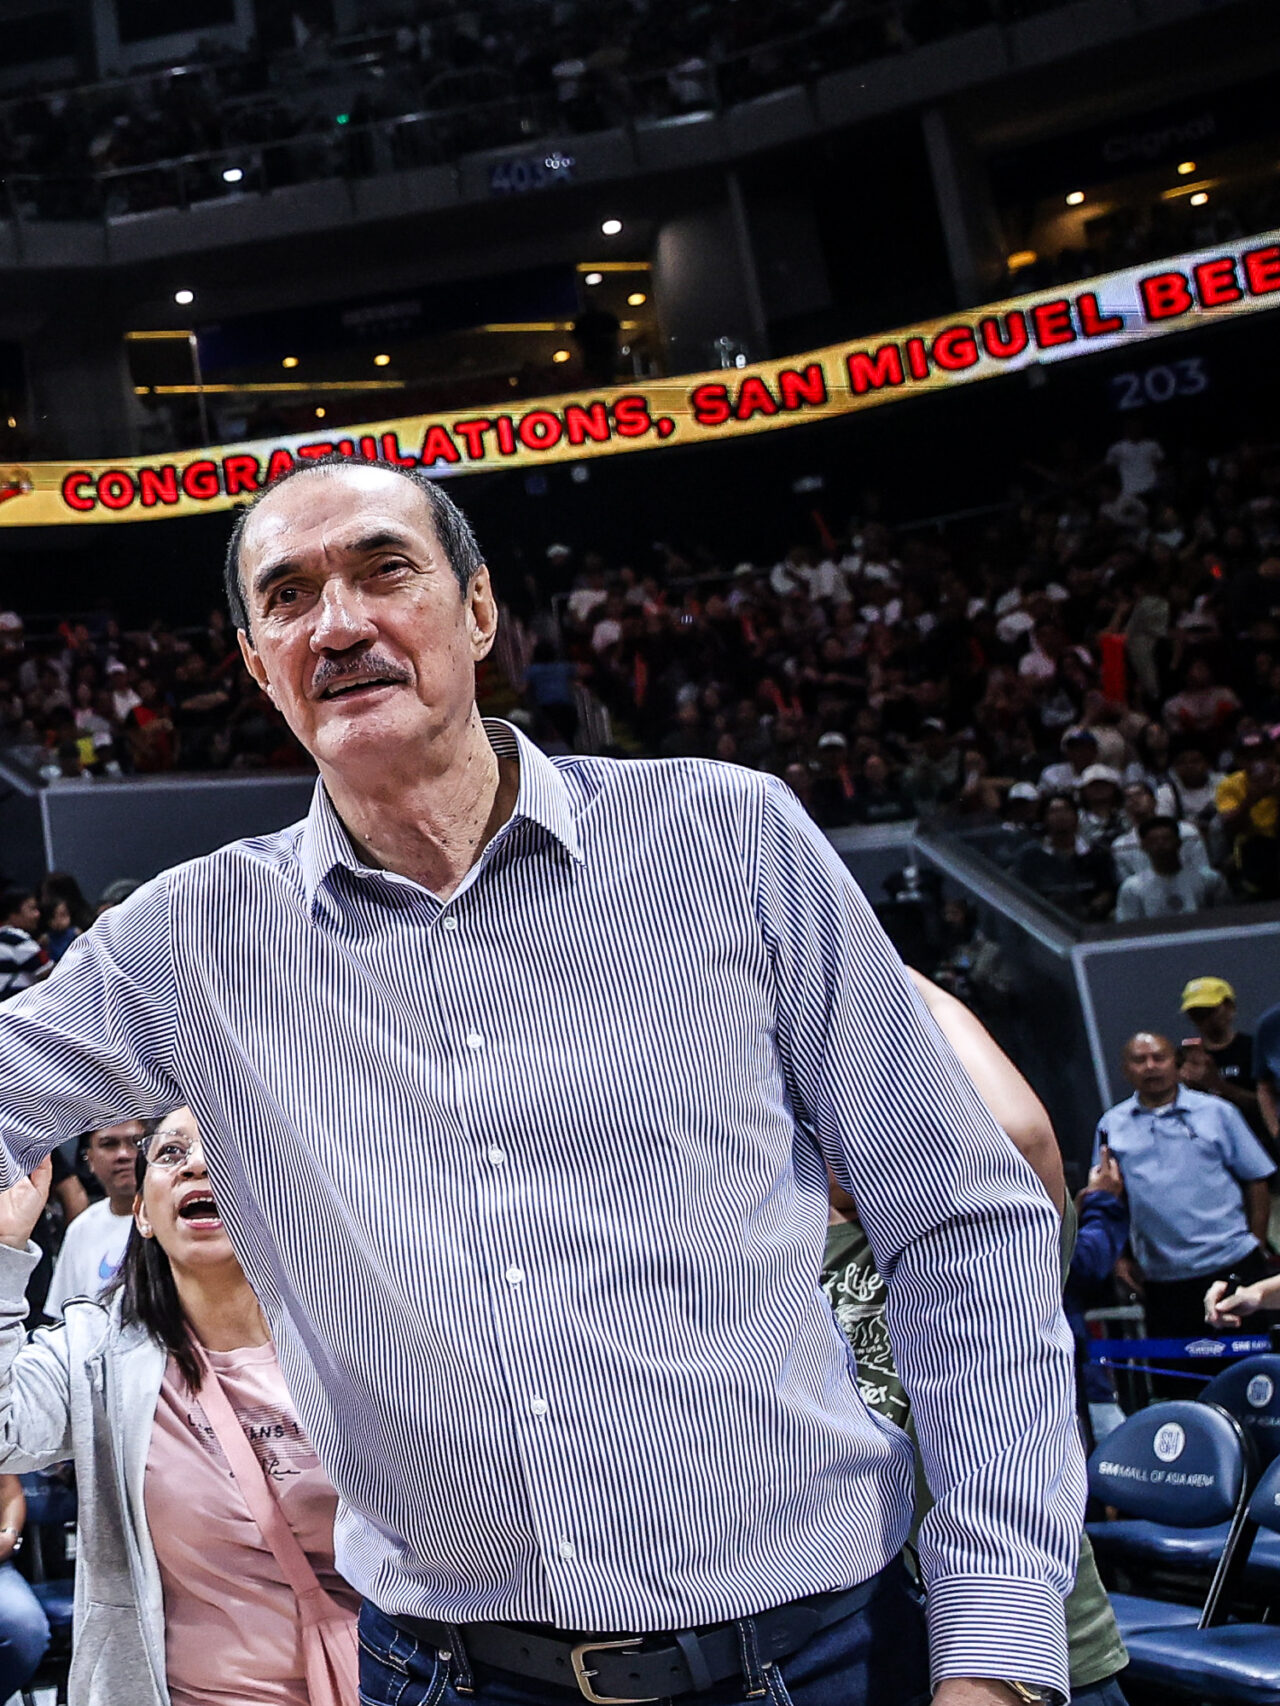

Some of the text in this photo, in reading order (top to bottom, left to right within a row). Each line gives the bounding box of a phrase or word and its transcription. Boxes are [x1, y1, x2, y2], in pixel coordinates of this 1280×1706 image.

[62, 396, 676, 511] CONGRALATIONS,
[691, 363, 828, 425] SAN
[847, 293, 1124, 395] MIGUEL
[1111, 358, 1209, 410] 203
[837, 1262, 884, 1301] Life
[1098, 1461, 1120, 1477] SM
[1119, 1464, 1148, 1482] MALL
[1150, 1470, 1166, 1483] OF
[1165, 1471, 1185, 1486] ASIA
